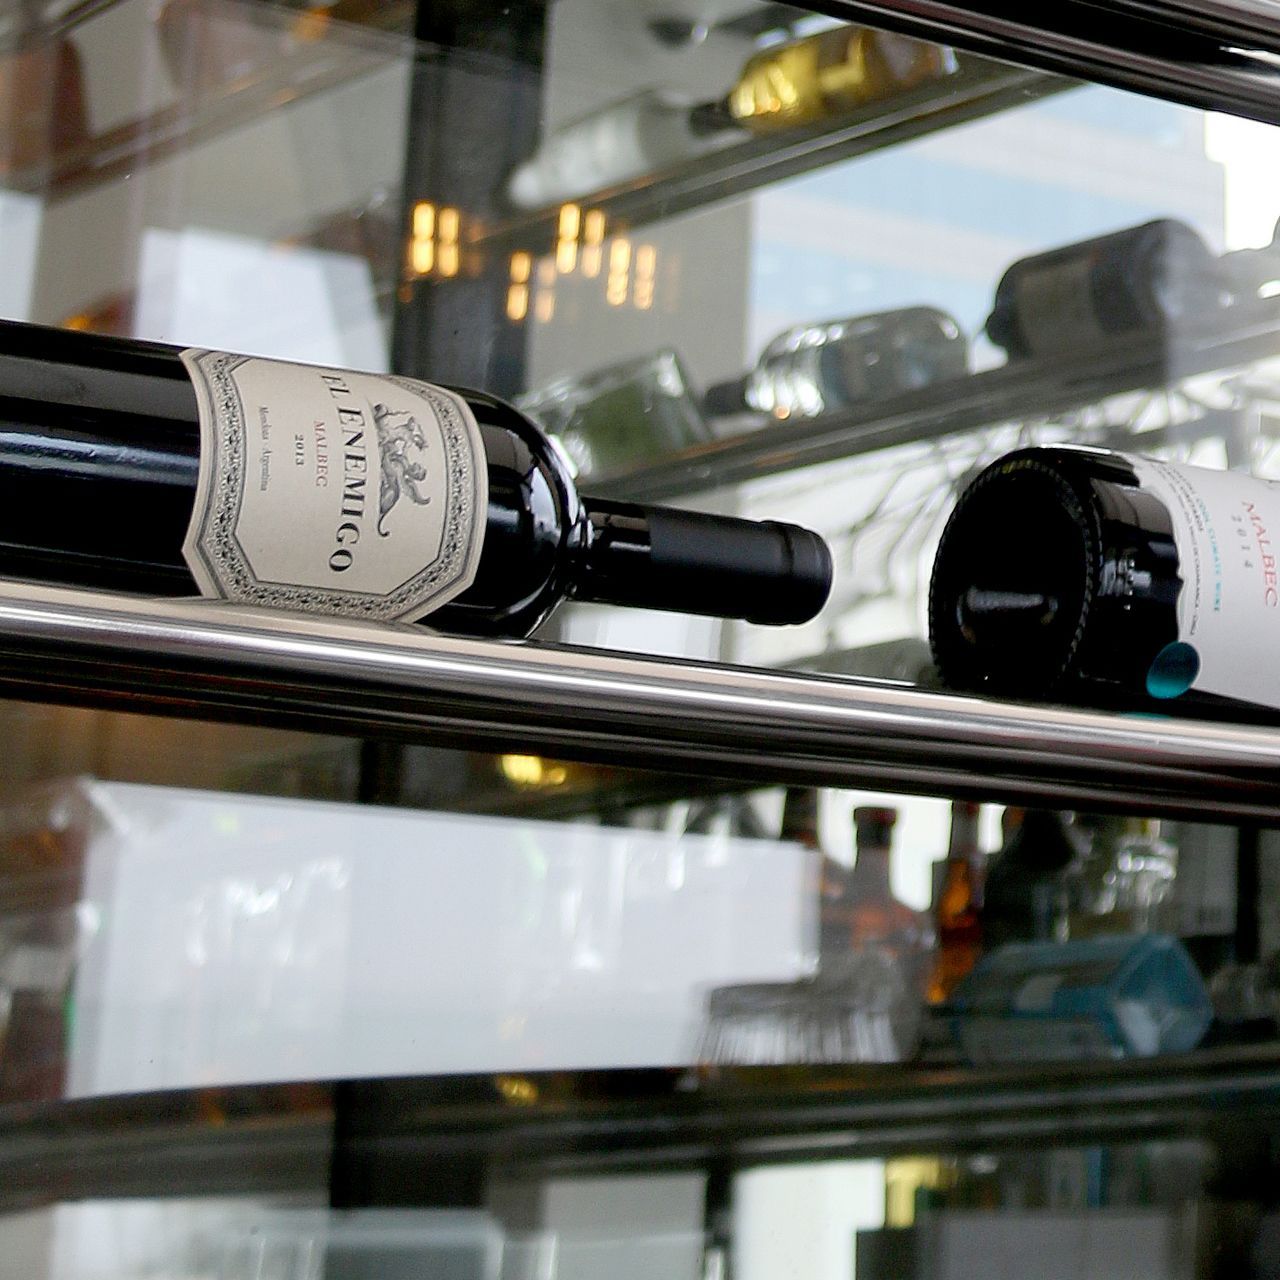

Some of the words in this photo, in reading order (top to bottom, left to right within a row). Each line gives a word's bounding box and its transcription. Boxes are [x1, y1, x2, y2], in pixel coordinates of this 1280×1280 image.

[319, 374, 351, 398] EL
[256, 405, 272, 440] Mendoza
[259, 447, 272, 491] Argentina
[294, 434, 304, 465] 2013
[313, 420, 328, 487] MALBEC
[327, 407, 366, 573] ENEMIGO
[1231, 514, 1251, 569] 2014
[1240, 500, 1278, 608] MALBEC
